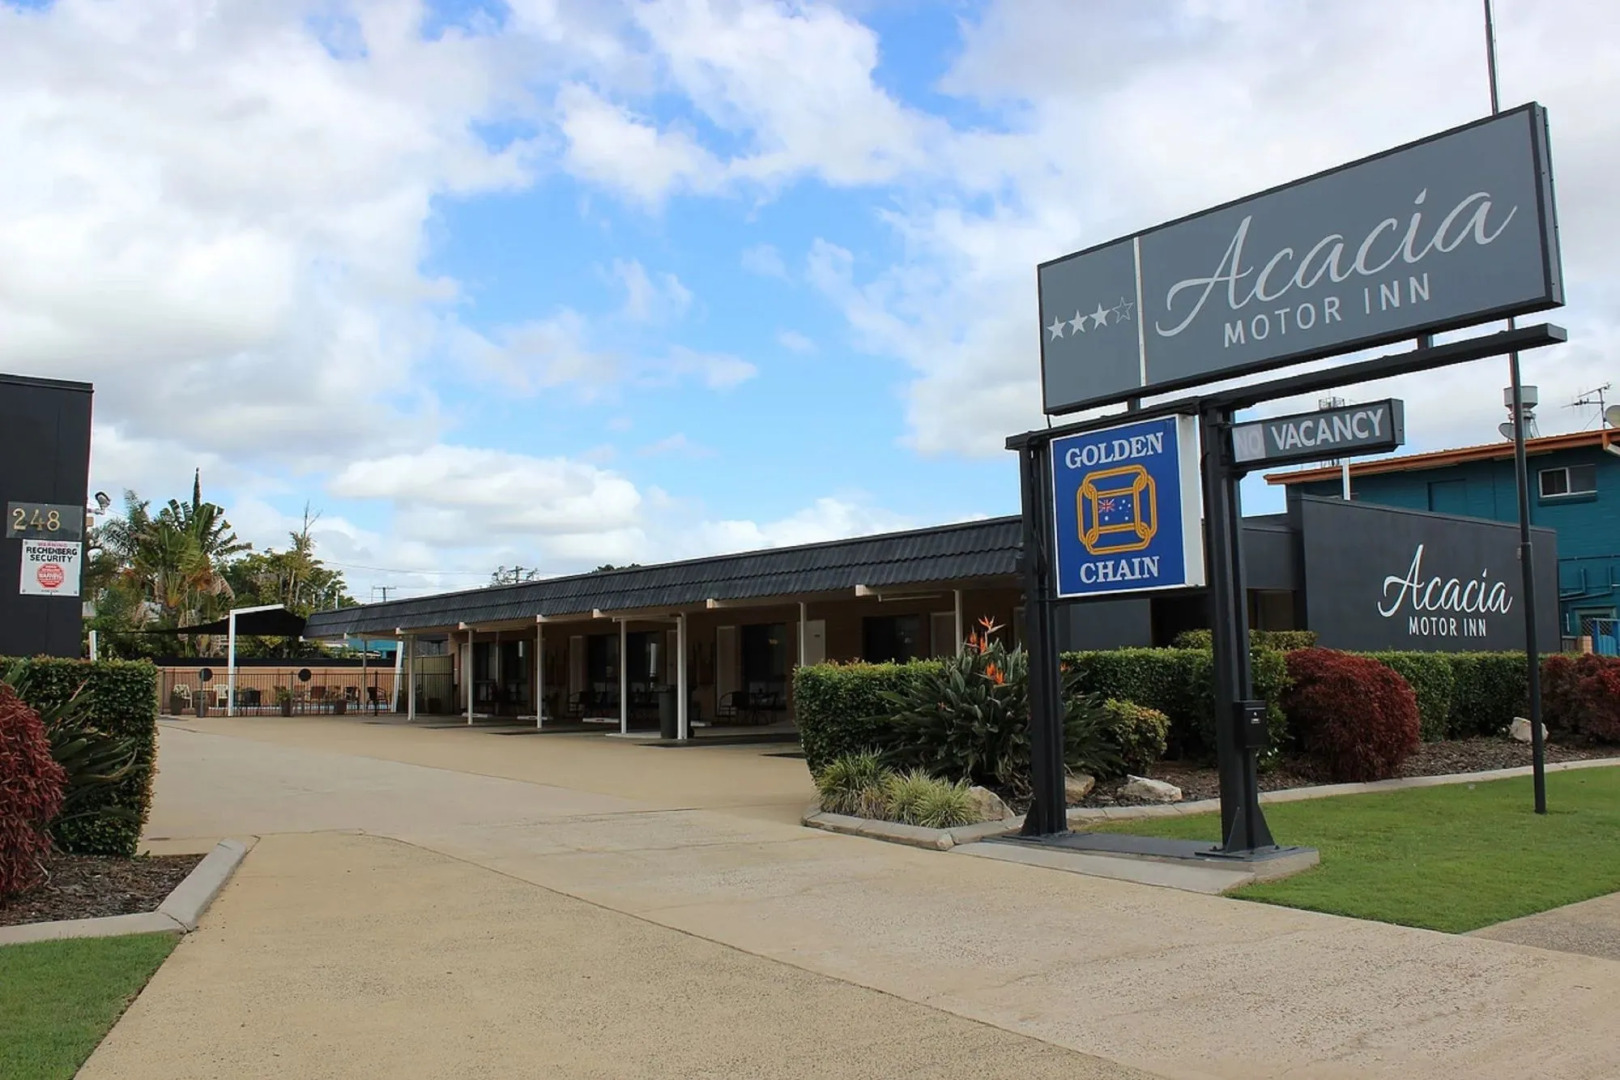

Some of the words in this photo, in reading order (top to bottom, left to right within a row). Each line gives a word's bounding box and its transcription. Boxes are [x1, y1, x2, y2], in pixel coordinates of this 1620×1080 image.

[1155, 187, 1518, 337] Acacia
[1223, 297, 1342, 348] MOTOR
[1363, 272, 1431, 314] INN
[1271, 408, 1384, 450] VACANCY
[1065, 432, 1164, 469] GOLDEN
[12, 507, 61, 532] 248
[26, 546, 78, 556] RECHENBERG
[30, 554, 73, 563] SECURITY
[1080, 556, 1160, 584] CHAIN
[1377, 544, 1513, 617] Acacia
[1409, 616, 1458, 637] MOTOR
[1463, 618, 1487, 637] INN
